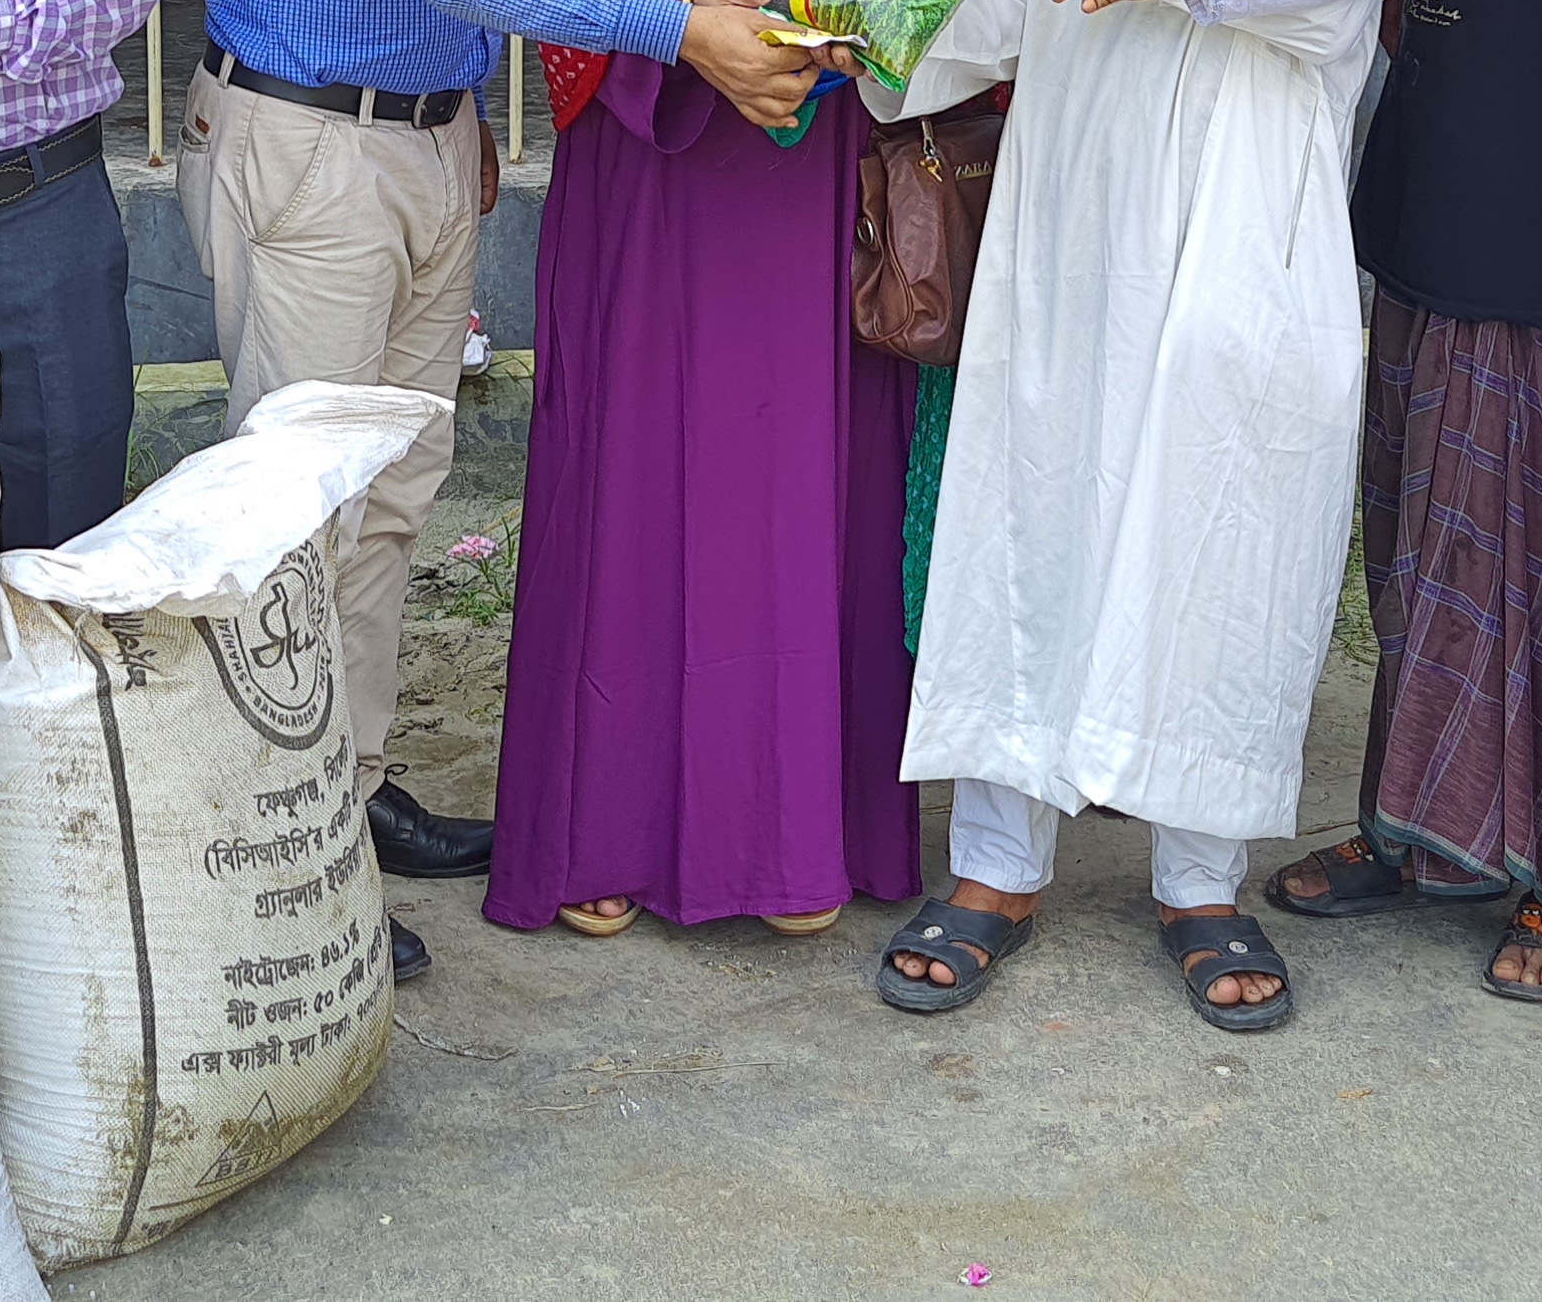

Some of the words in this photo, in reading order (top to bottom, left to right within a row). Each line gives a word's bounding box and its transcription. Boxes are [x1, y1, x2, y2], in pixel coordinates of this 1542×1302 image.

[216, 617, 248, 683] SHAHJAL
[224, 998, 258, 1032] নীট
[314, 990, 333, 1013] ৫০
